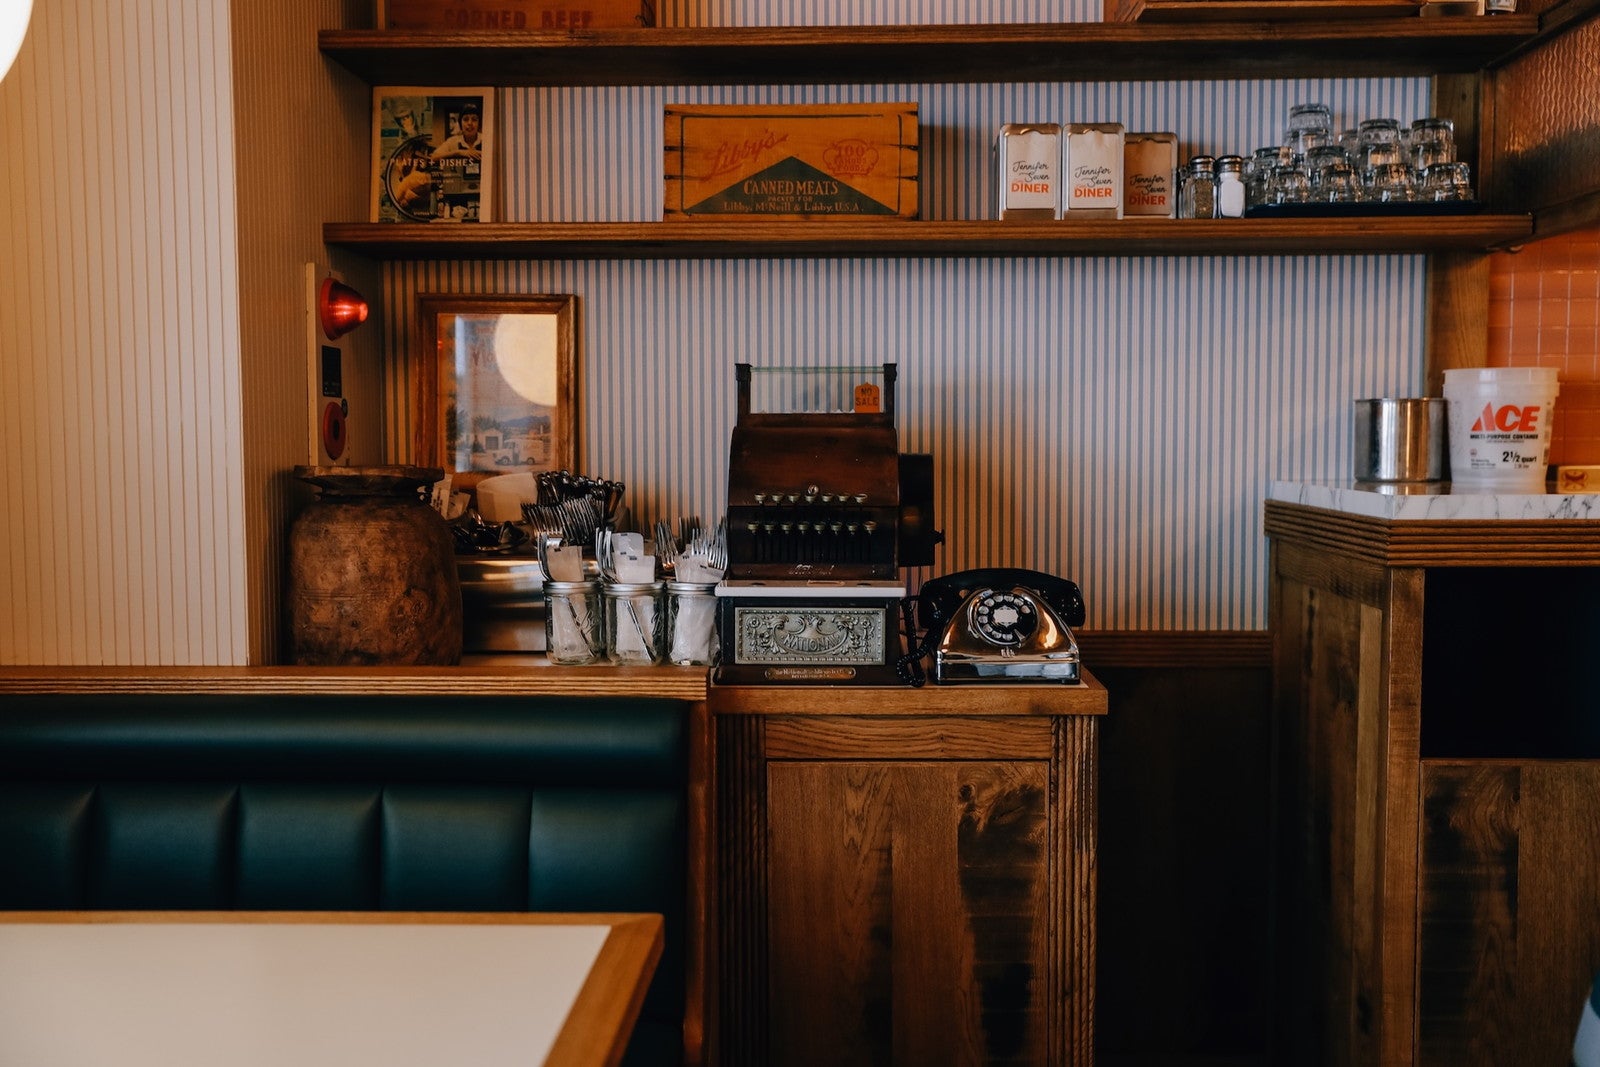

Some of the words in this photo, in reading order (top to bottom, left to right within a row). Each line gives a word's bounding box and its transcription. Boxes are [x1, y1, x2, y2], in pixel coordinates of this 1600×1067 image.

[444, 9, 527, 29] CORNED
[541, 10, 593, 29] BEEF
[701, 128, 788, 181] Libby's
[439, 158, 475, 168] DISHES
[1012, 160, 1049, 173] Jennifer
[1019, 171, 1050, 183] Seven
[1074, 166, 1112, 179] Jennifer
[1081, 176, 1113, 188] Seven
[1129, 174, 1165, 186] Jennifer
[743, 180, 794, 195] CANNED
[796, 180, 839, 195] MEATS
[1011, 183, 1049, 193] DINER
[1074, 188, 1112, 198] DINER
[1136, 184, 1166, 195] Seven
[1129, 195, 1165, 205] DINER
[861, 388, 872, 396] NO
[856, 397, 878, 406] SALE
[1471, 402, 1541, 432] ACE
[783, 634, 840, 652] NATIONAL
